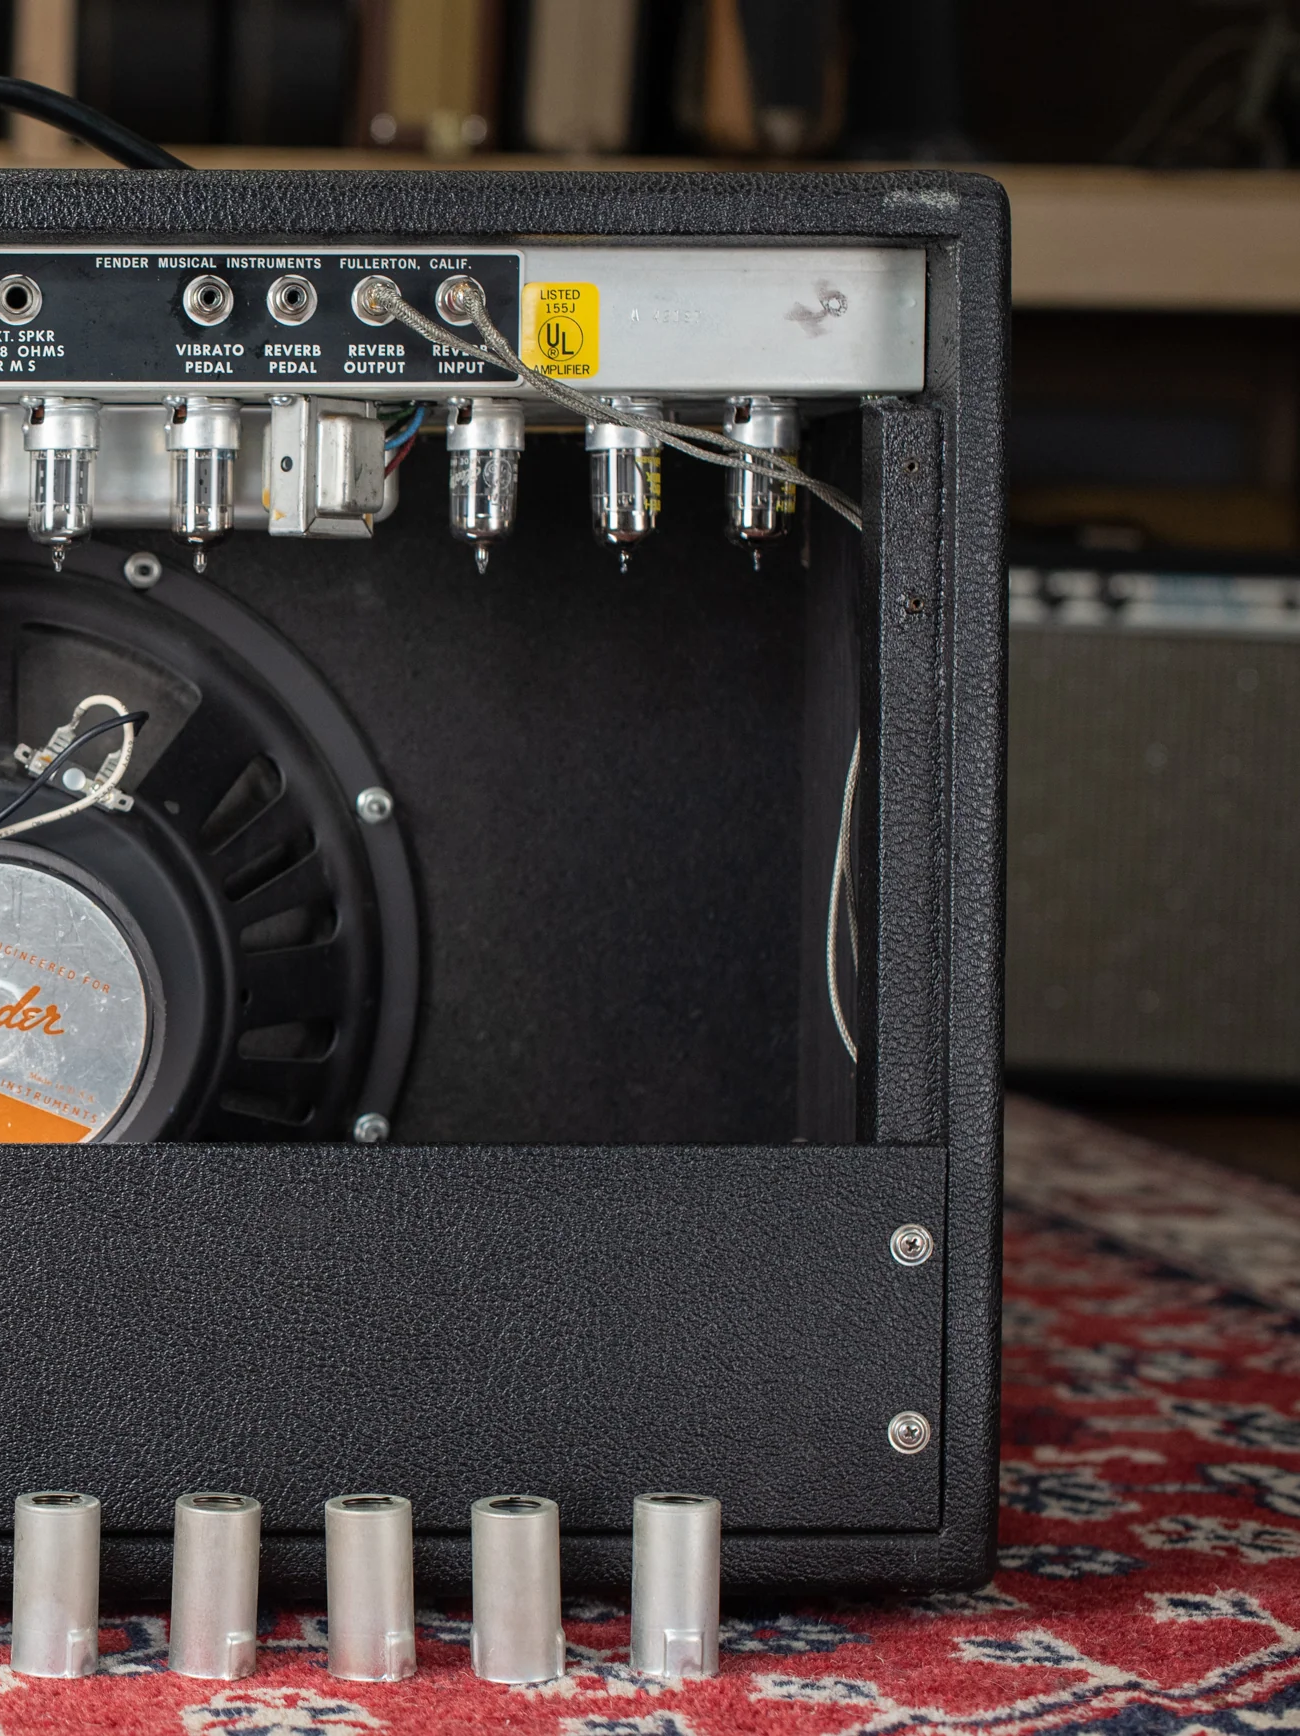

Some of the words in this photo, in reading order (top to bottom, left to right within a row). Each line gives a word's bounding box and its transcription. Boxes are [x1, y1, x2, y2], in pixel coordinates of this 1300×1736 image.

[95, 257, 149, 269] FENDER
[158, 257, 217, 269] MUSICAL
[226, 257, 322, 269] INSTRUMENTS
[429, 258, 472, 270] CALIF.
[540, 289, 581, 301] LISTED
[546, 302, 575, 314] 155J
[18, 330, 55, 343] SPKR
[546, 322, 575, 356] UL
[0, 345, 9, 358] 8
[17, 345, 65, 358] OHMS
[175, 343, 245, 357] VIBRATO
[264, 344, 322, 357] REVERB
[348, 344, 406, 357] REVERB
[9, 360, 24, 372] M
[27, 360, 37, 373] S
[185, 361, 234, 374] PEDAL
[269, 361, 318, 374] PEDAL
[343, 361, 406, 374] OUTPUT
[438, 361, 485, 374] INPUT
[533, 364, 590, 376] AMPLIFIER
[82, 976, 111, 994] FOR
[0, 1079, 99, 1124] INSTRUMENTS
